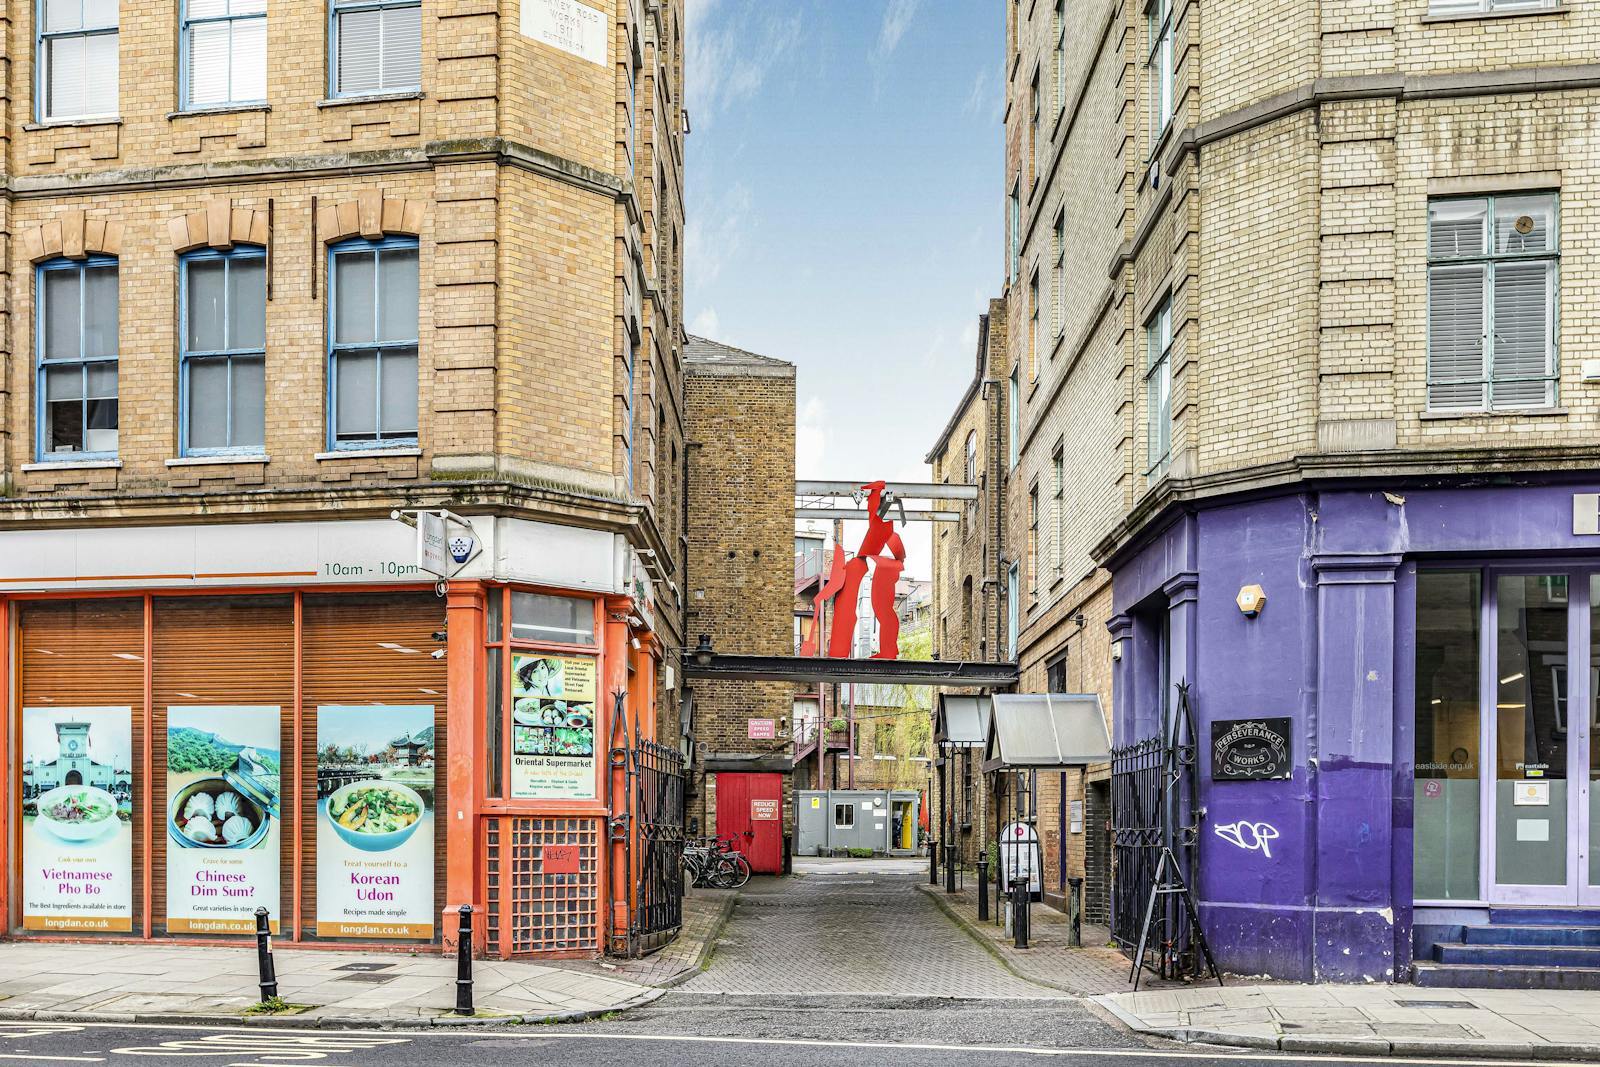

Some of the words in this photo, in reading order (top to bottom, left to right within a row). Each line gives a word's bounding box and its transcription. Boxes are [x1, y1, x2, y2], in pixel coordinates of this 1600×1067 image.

[550, 9, 581, 28] WORKS
[324, 563, 363, 576] 10am
[381, 562, 419, 577] 10pm
[1217, 728, 1282, 749] PERSEVERANCE
[515, 757, 544, 766] Oriental
[546, 758, 592, 768] Supermarket
[1233, 754, 1265, 765] WORKS
[1415, 762, 1474, 771] eastside.org.uk
[364, 860, 392, 869] yourself
[394, 860, 401, 868] to
[42, 868, 113, 880] Vietnamese
[195, 870, 246, 882] Chinese
[351, 872, 400, 885] Korean
[58, 883, 81, 894] Pho
[85, 883, 101, 894] Bo
[191, 885, 217, 896] Dim
[222, 885, 255, 897] Sum?
[357, 888, 394, 901] Udon
[53, 903, 81, 911] Ingredients
[343, 908, 367, 917] Recipes
[368, 908, 385, 916] made
[386, 908, 407, 917] simple
[45, 918, 109, 929] longdan.co.uk
[189, 920, 256, 931] longdan.co.uk
[340, 924, 409, 935] longdan.co.uk
[109, 1034, 412, 1060] BUS
